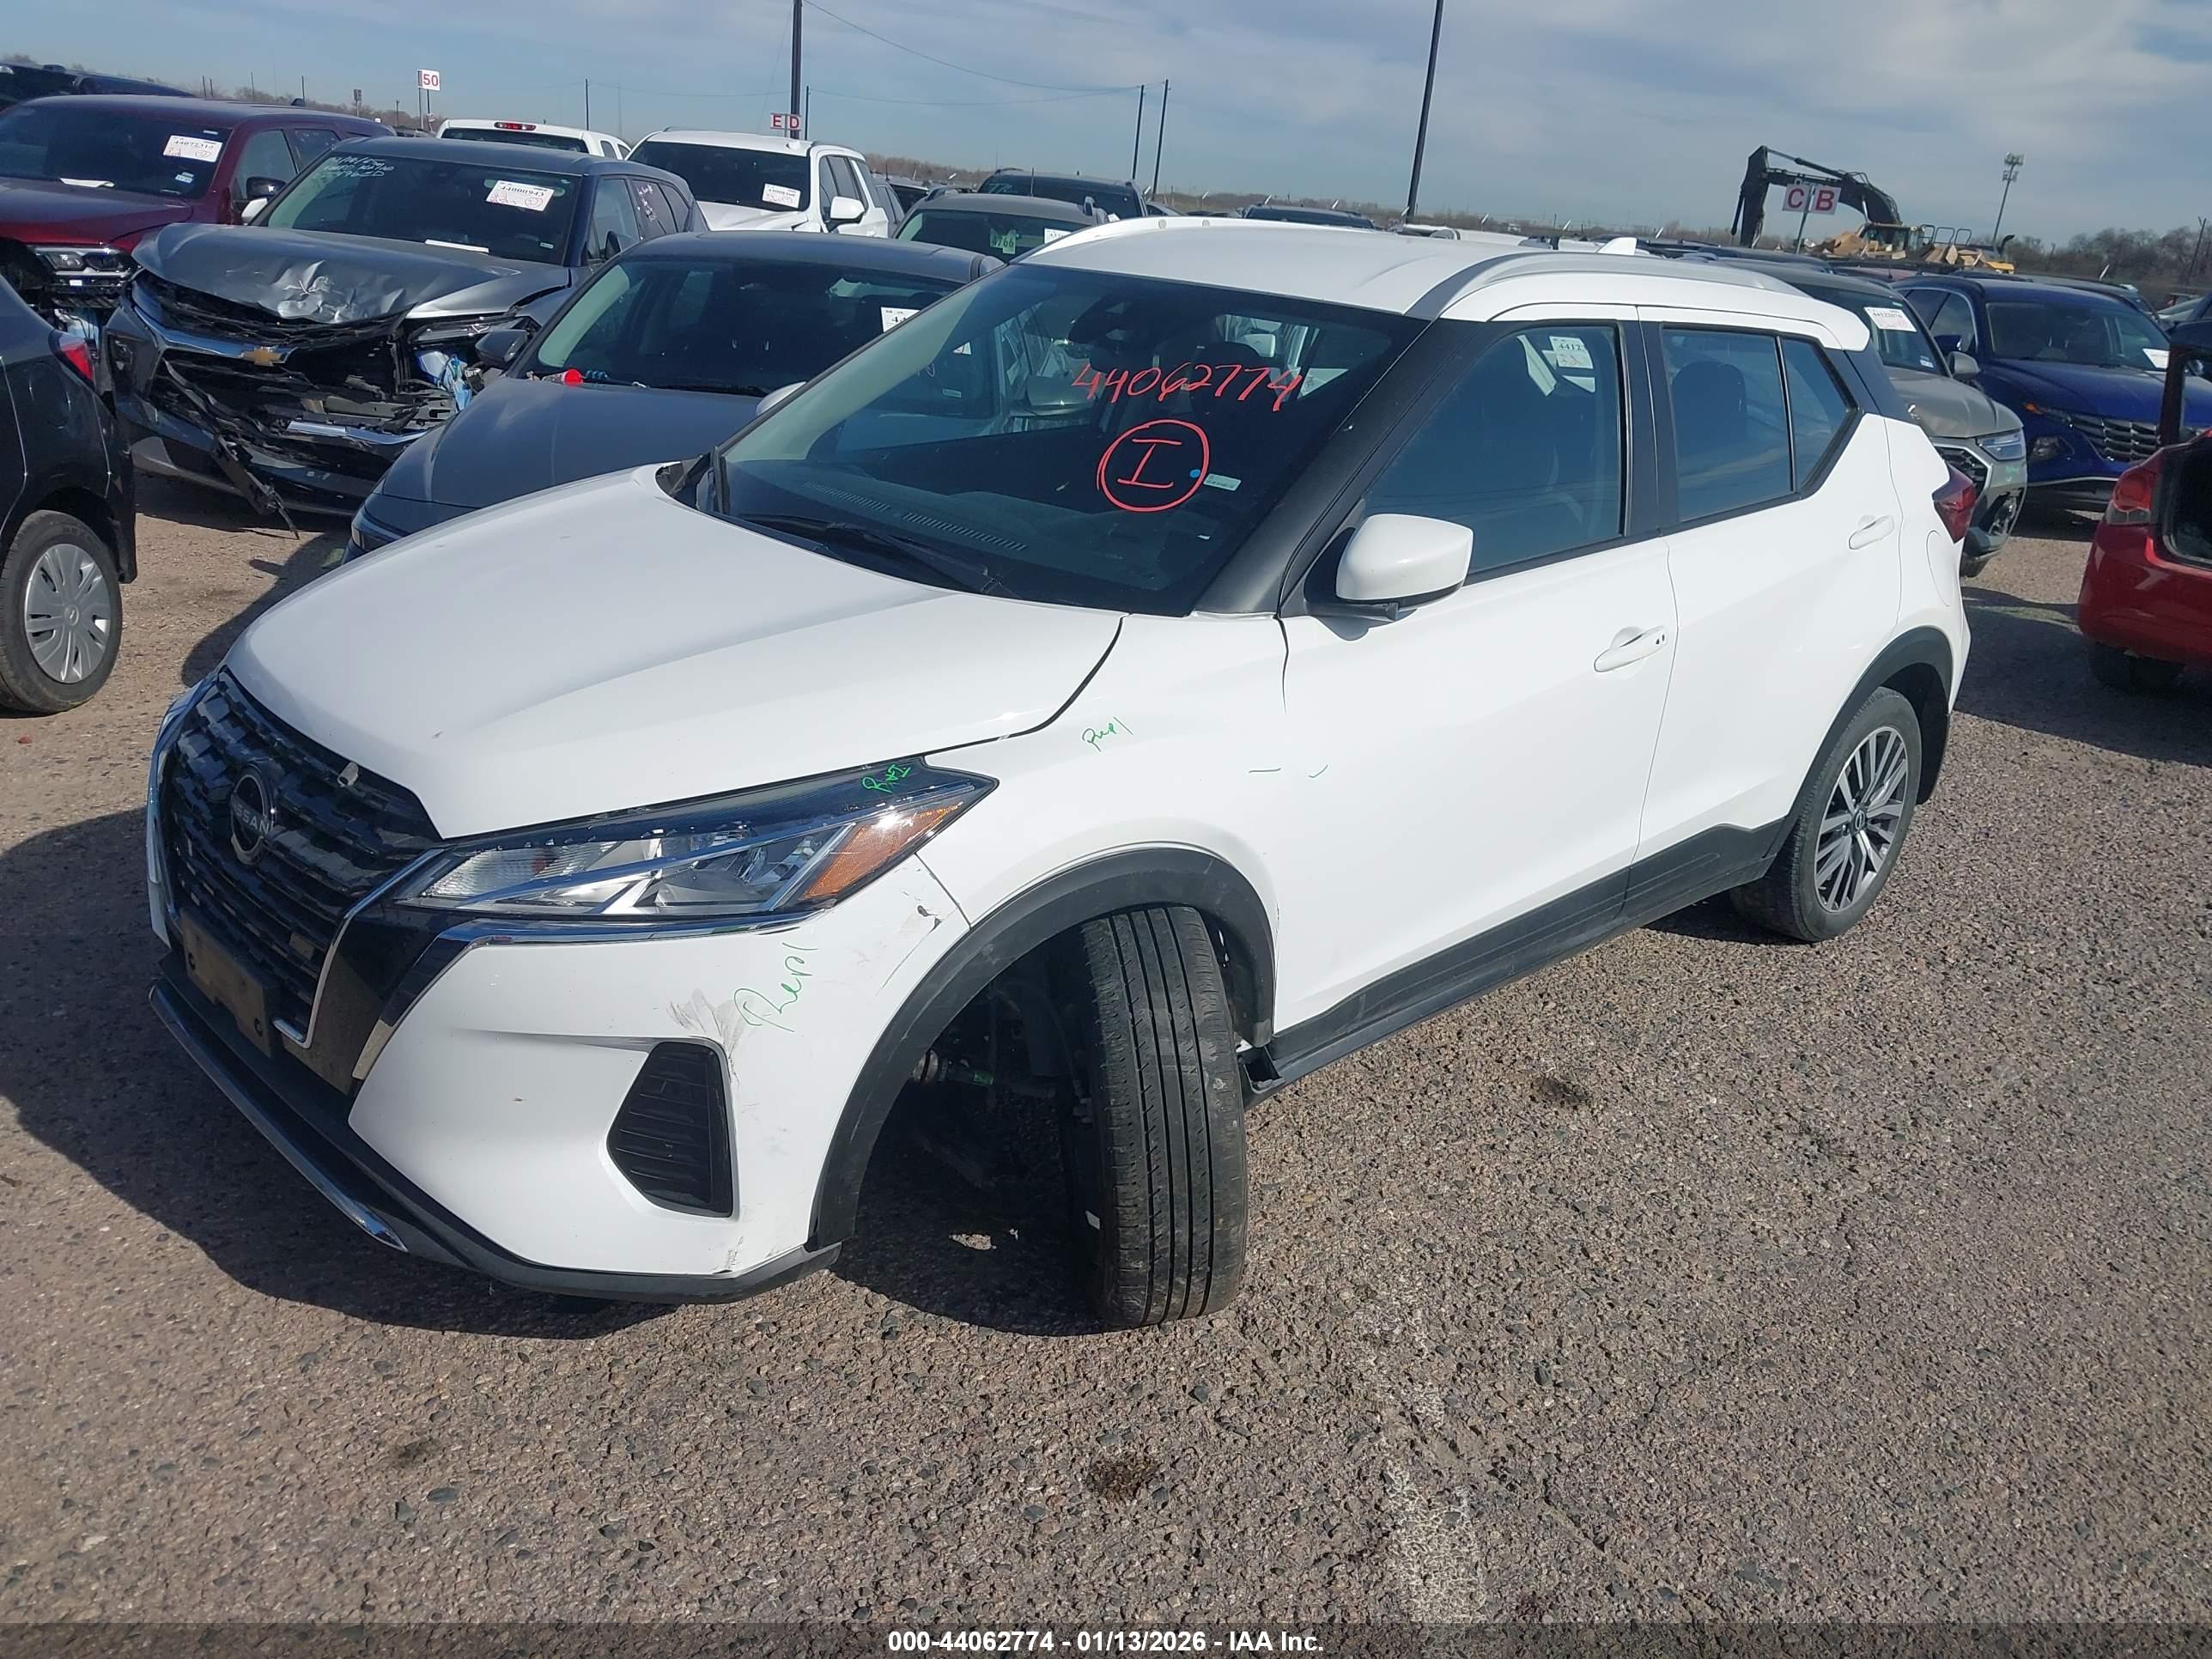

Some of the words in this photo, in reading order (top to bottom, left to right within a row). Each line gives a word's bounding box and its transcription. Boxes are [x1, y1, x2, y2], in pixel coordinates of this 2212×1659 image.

[422, 74, 439, 87] 50
[773, 115, 782, 128] E
[789, 116, 799, 129] D
[1787, 187, 1805, 209] C
[1815, 189, 1835, 211] B
[1071, 362, 1304, 413] 44062774
